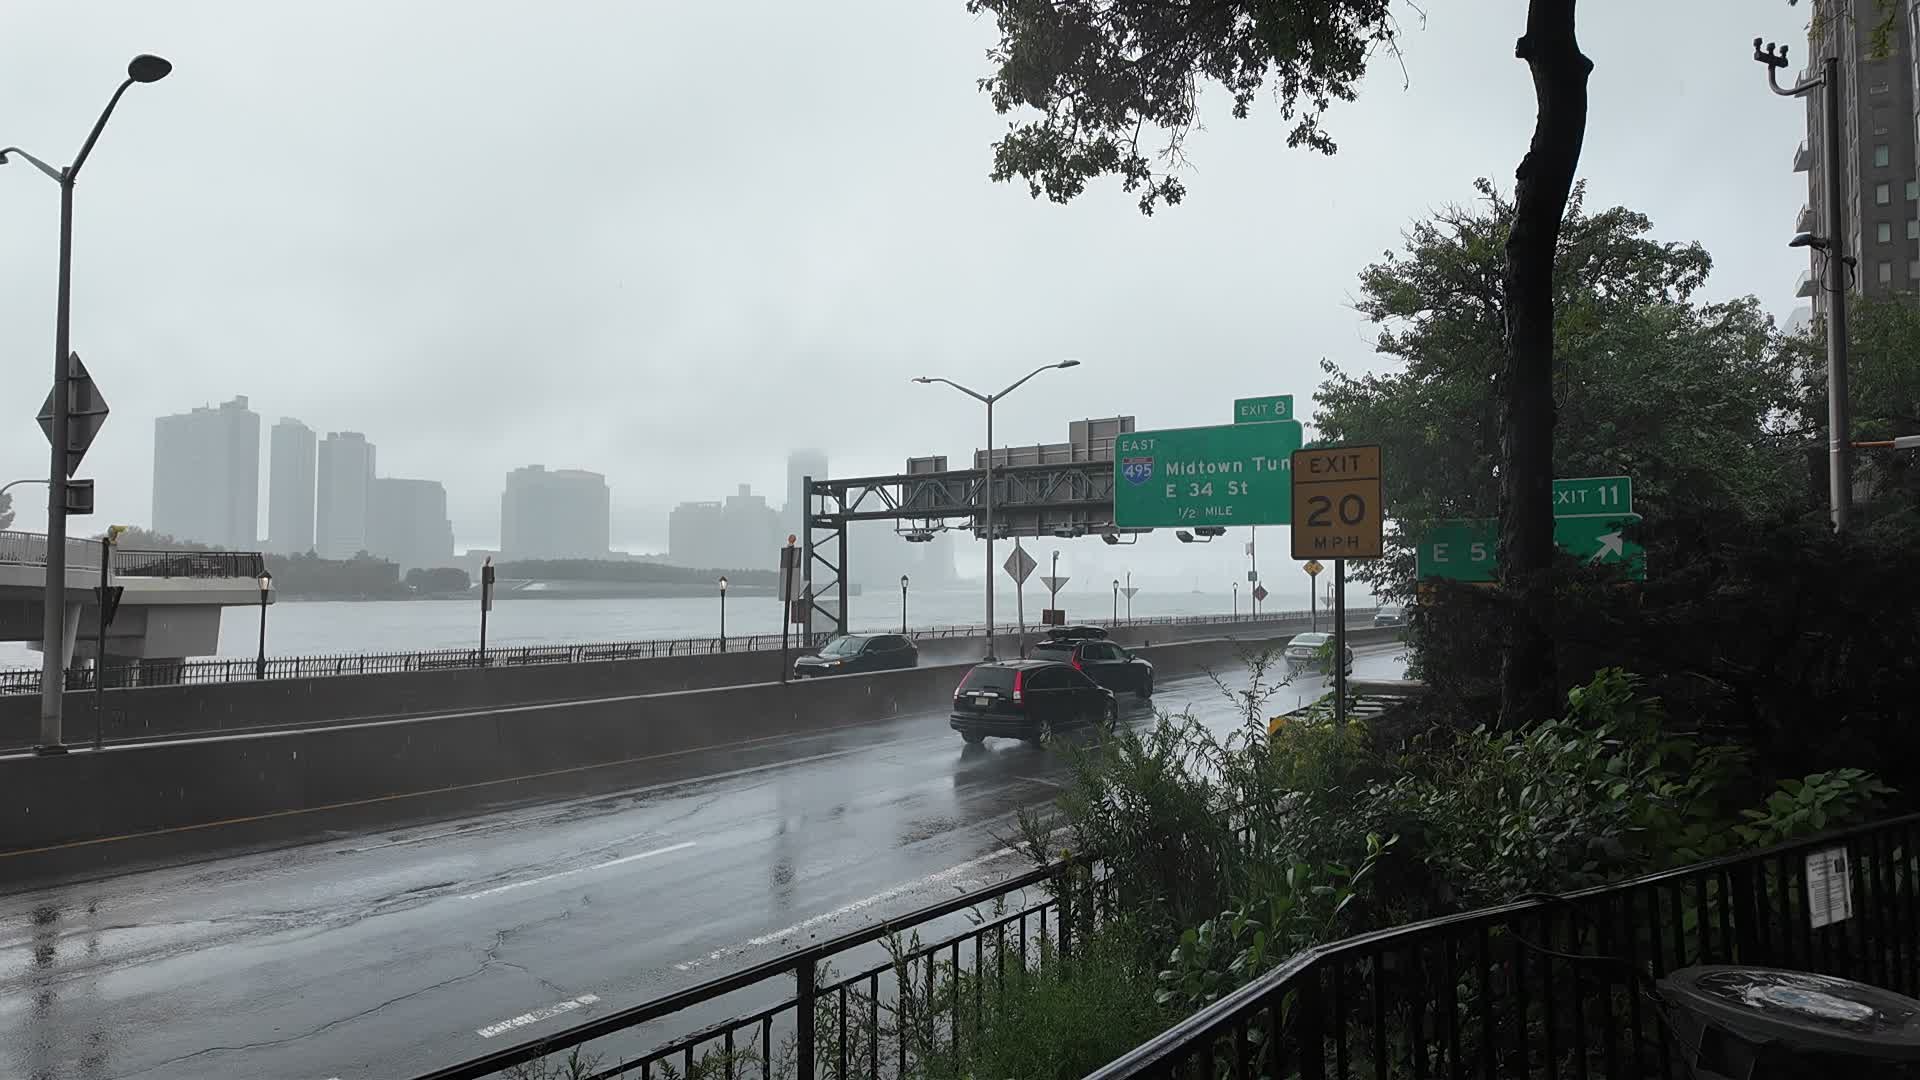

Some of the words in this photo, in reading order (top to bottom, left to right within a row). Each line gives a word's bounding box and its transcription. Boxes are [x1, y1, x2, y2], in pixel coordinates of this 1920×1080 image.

[1241, 404, 1268, 416] EXIT
[1274, 401, 1286, 415] 8
[1122, 439, 1155, 452] EAST
[1124, 464, 1152, 478] 495
[1166, 458, 1243, 476] Midtown
[1310, 455, 1361, 473] EXIT
[1166, 484, 1176, 498] E
[1189, 482, 1214, 497] 34
[1228, 481, 1248, 496] St
[1552, 489, 1589, 505] XIT
[1599, 485, 1619, 505] 11
[1178, 506, 1196, 519] 1/2
[1205, 506, 1233, 516] MILE
[1307, 494, 1366, 527] 20
[1314, 536, 1359, 549] MPH
[1433, 543, 1449, 562] E
[1470, 543, 1497, 562] 5
